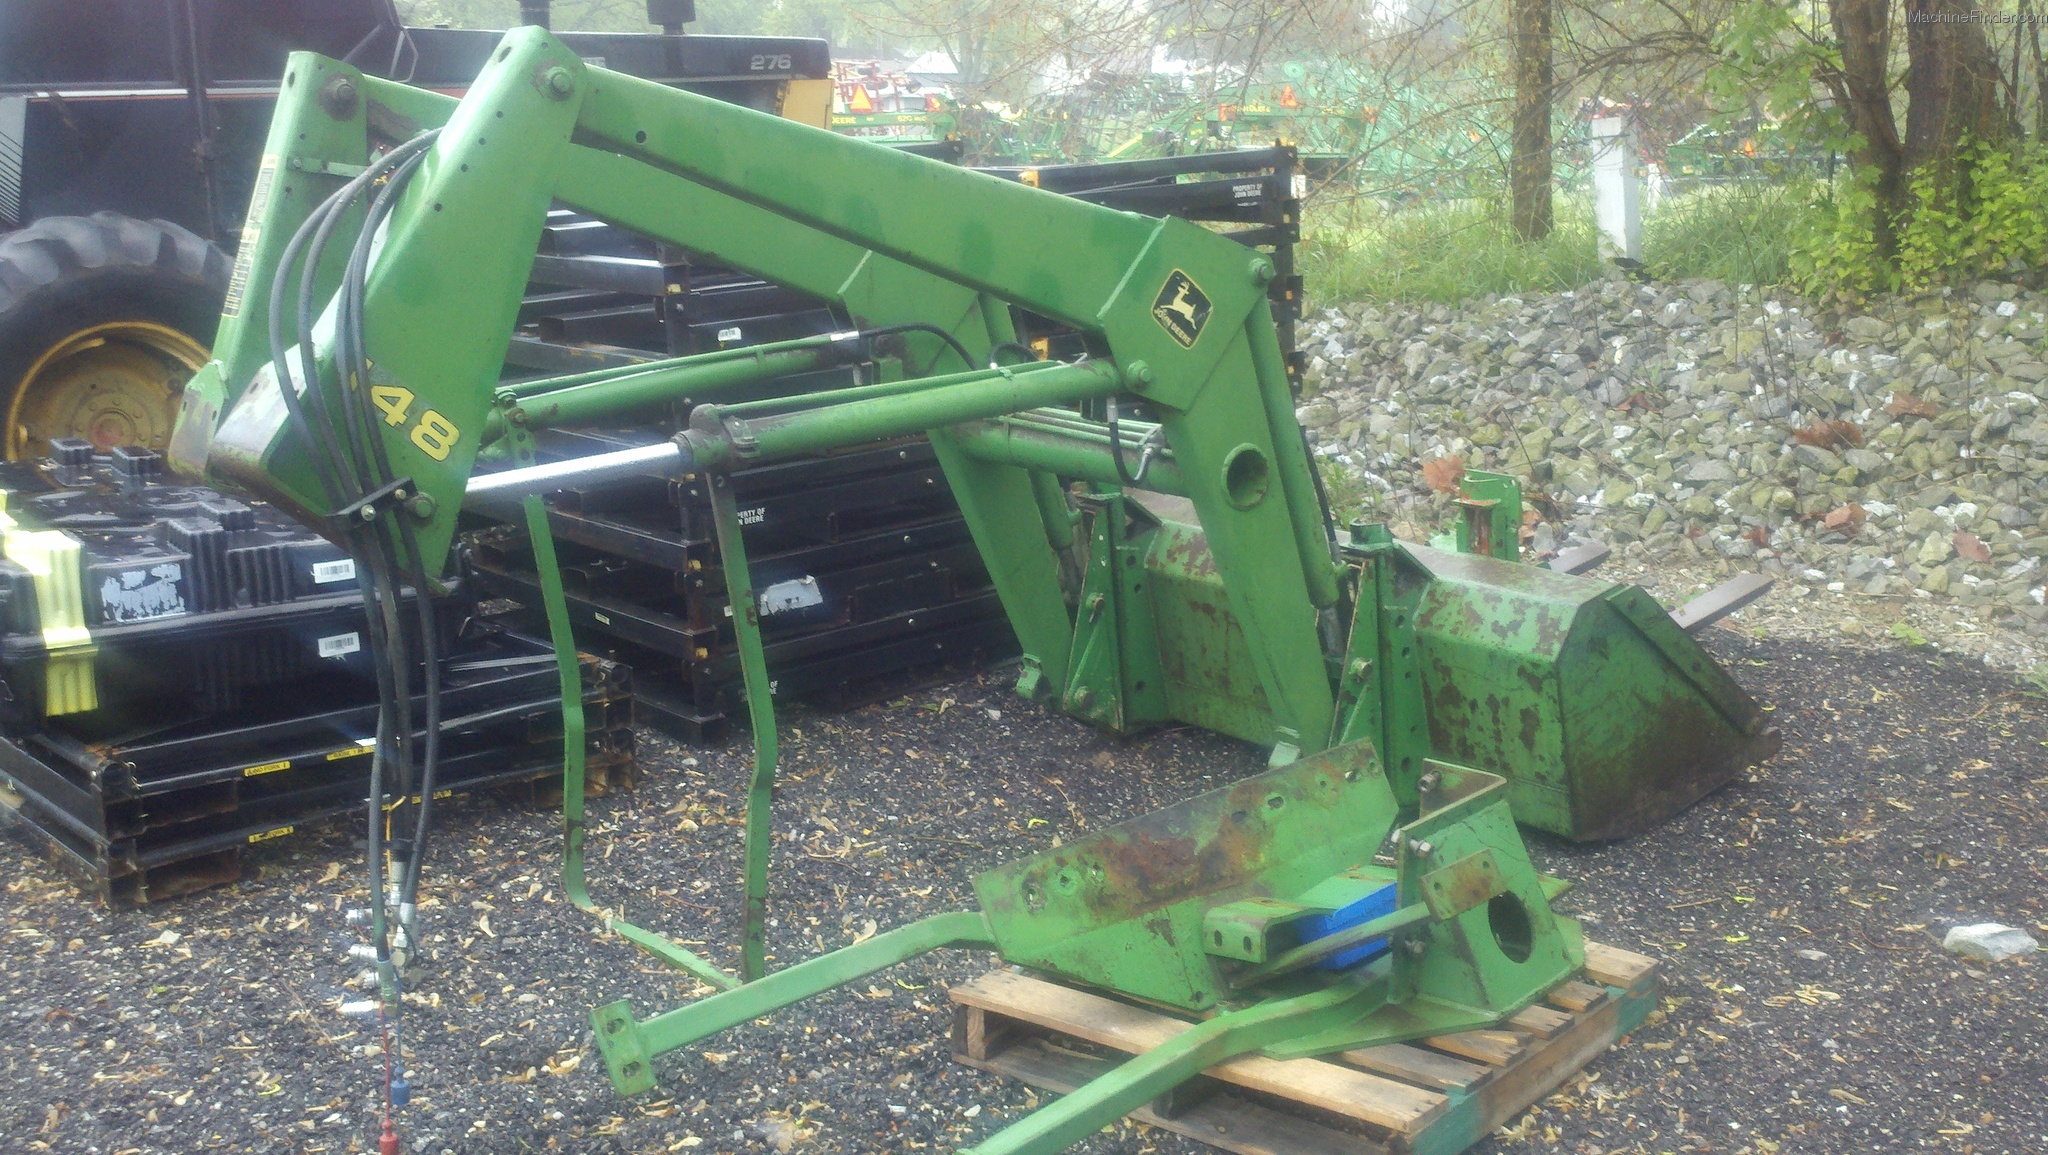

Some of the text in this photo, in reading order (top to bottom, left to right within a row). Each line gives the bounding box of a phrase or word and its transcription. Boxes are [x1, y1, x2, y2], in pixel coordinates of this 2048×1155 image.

[750, 54, 792, 70] 276
[1154, 308, 1192, 346] JOHN DEERE
[756, 507, 766, 516] OF
[744, 515, 765, 525] DEERE
[770, 680, 779, 688] OF
